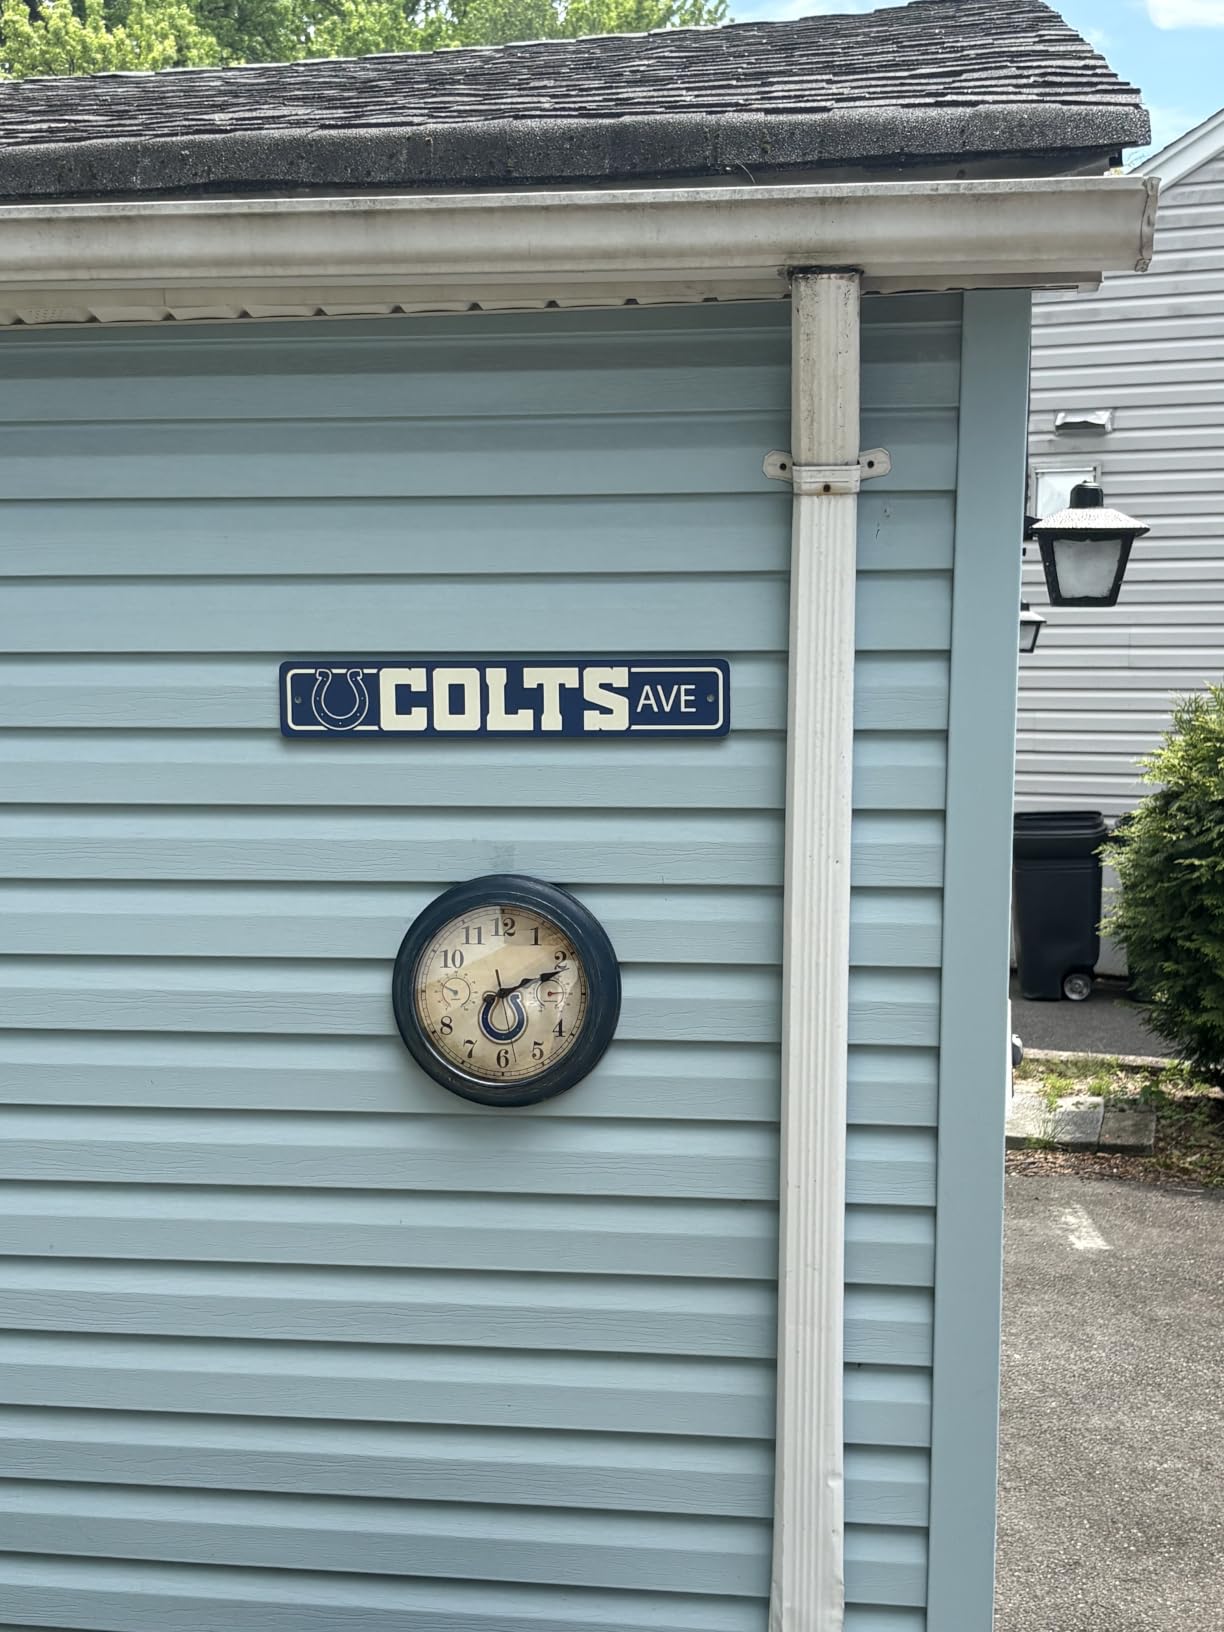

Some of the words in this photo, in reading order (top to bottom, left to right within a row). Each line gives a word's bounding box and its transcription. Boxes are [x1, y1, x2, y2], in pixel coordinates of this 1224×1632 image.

[379, 667, 630, 732] COLTS
[637, 684, 697, 713] AVE
[461, 926, 486, 945] 11
[490, 917, 516, 937] 12
[530, 927, 542, 946] 1
[439, 949, 465, 969] 10
[554, 950, 567, 970] 2
[440, 1015, 453, 1035] 8
[552, 1018, 566, 1038] 4
[463, 1039, 477, 1059] 7
[496, 1048, 509, 1068] 6
[531, 1041, 544, 1060] 5
